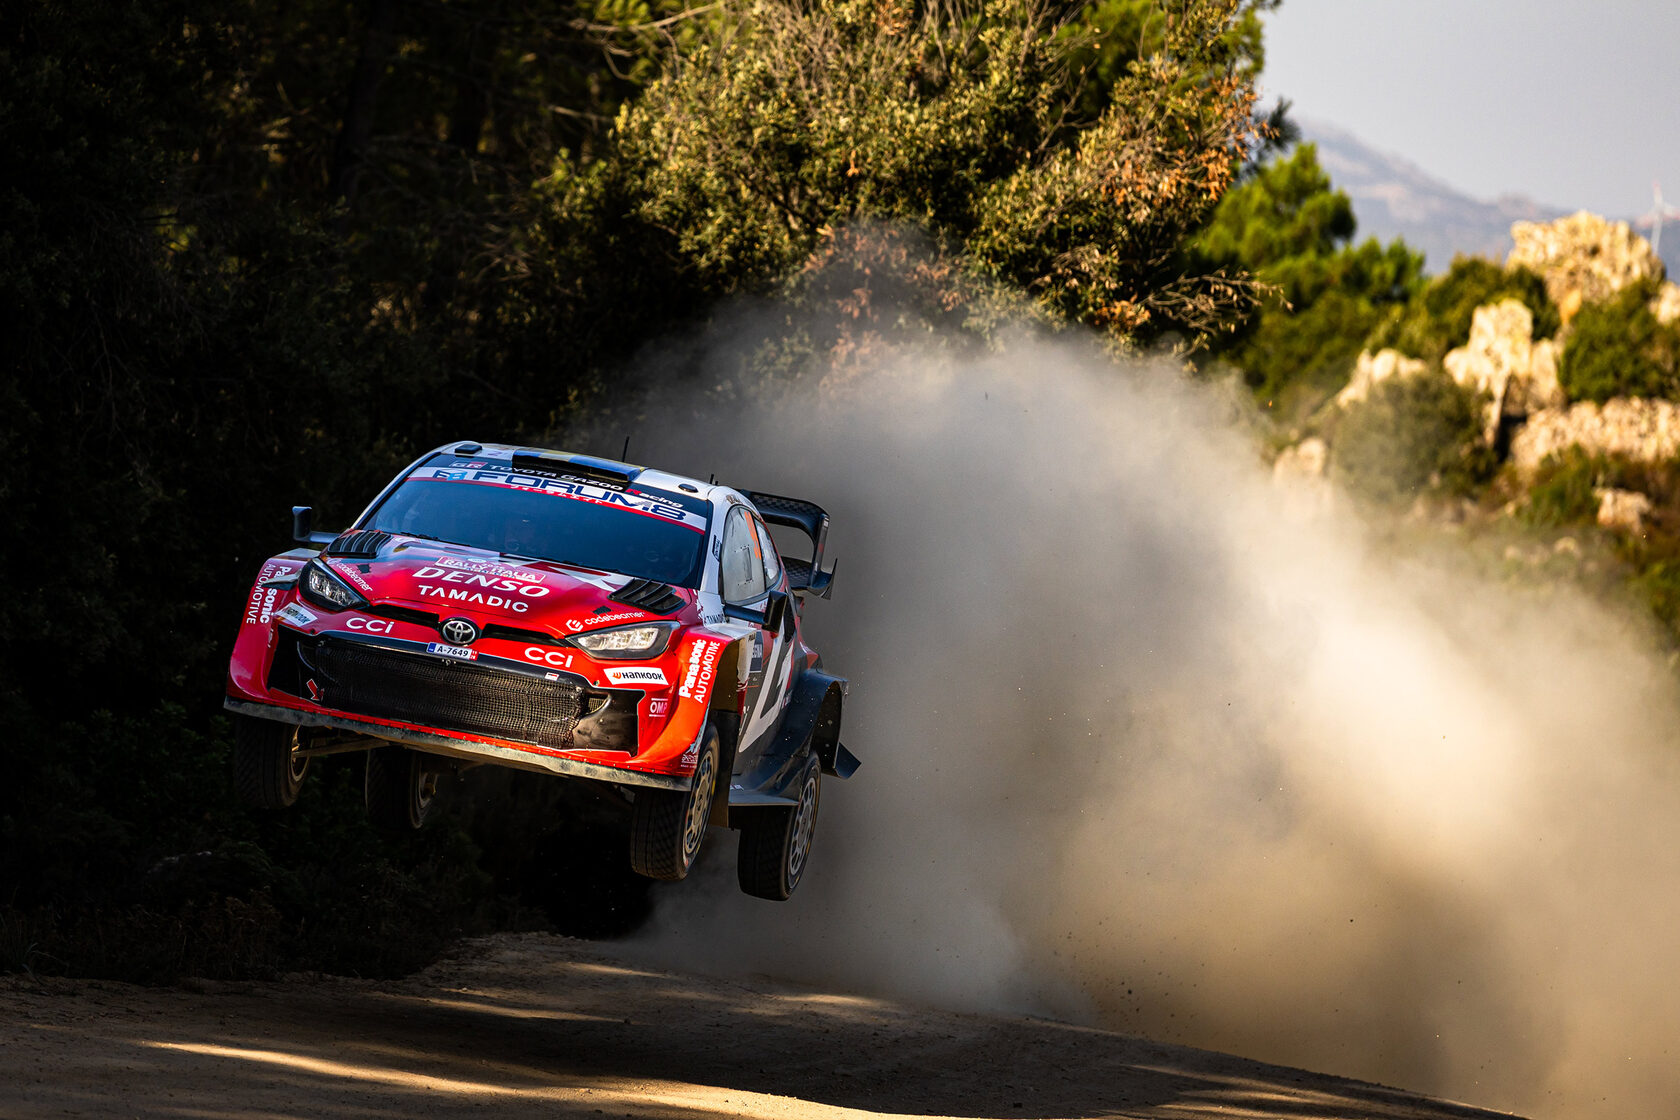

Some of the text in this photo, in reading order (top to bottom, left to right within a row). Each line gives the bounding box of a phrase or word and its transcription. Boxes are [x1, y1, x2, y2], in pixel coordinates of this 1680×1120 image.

[472, 470, 687, 521] FORUM8
[490, 464, 557, 478] TOYOTA
[560, 474, 623, 491] GAZOO
[625, 488, 684, 508] Racing
[412, 566, 550, 597] DENSO
[443, 559, 487, 573] RALLY
[490, 567, 536, 580] ITALIA
[418, 585, 529, 613] TAMADIC
[584, 611, 645, 626] codebeamer
[678, 639, 707, 698] Panasonic
[694, 641, 721, 703] AUTOMOTIVE
